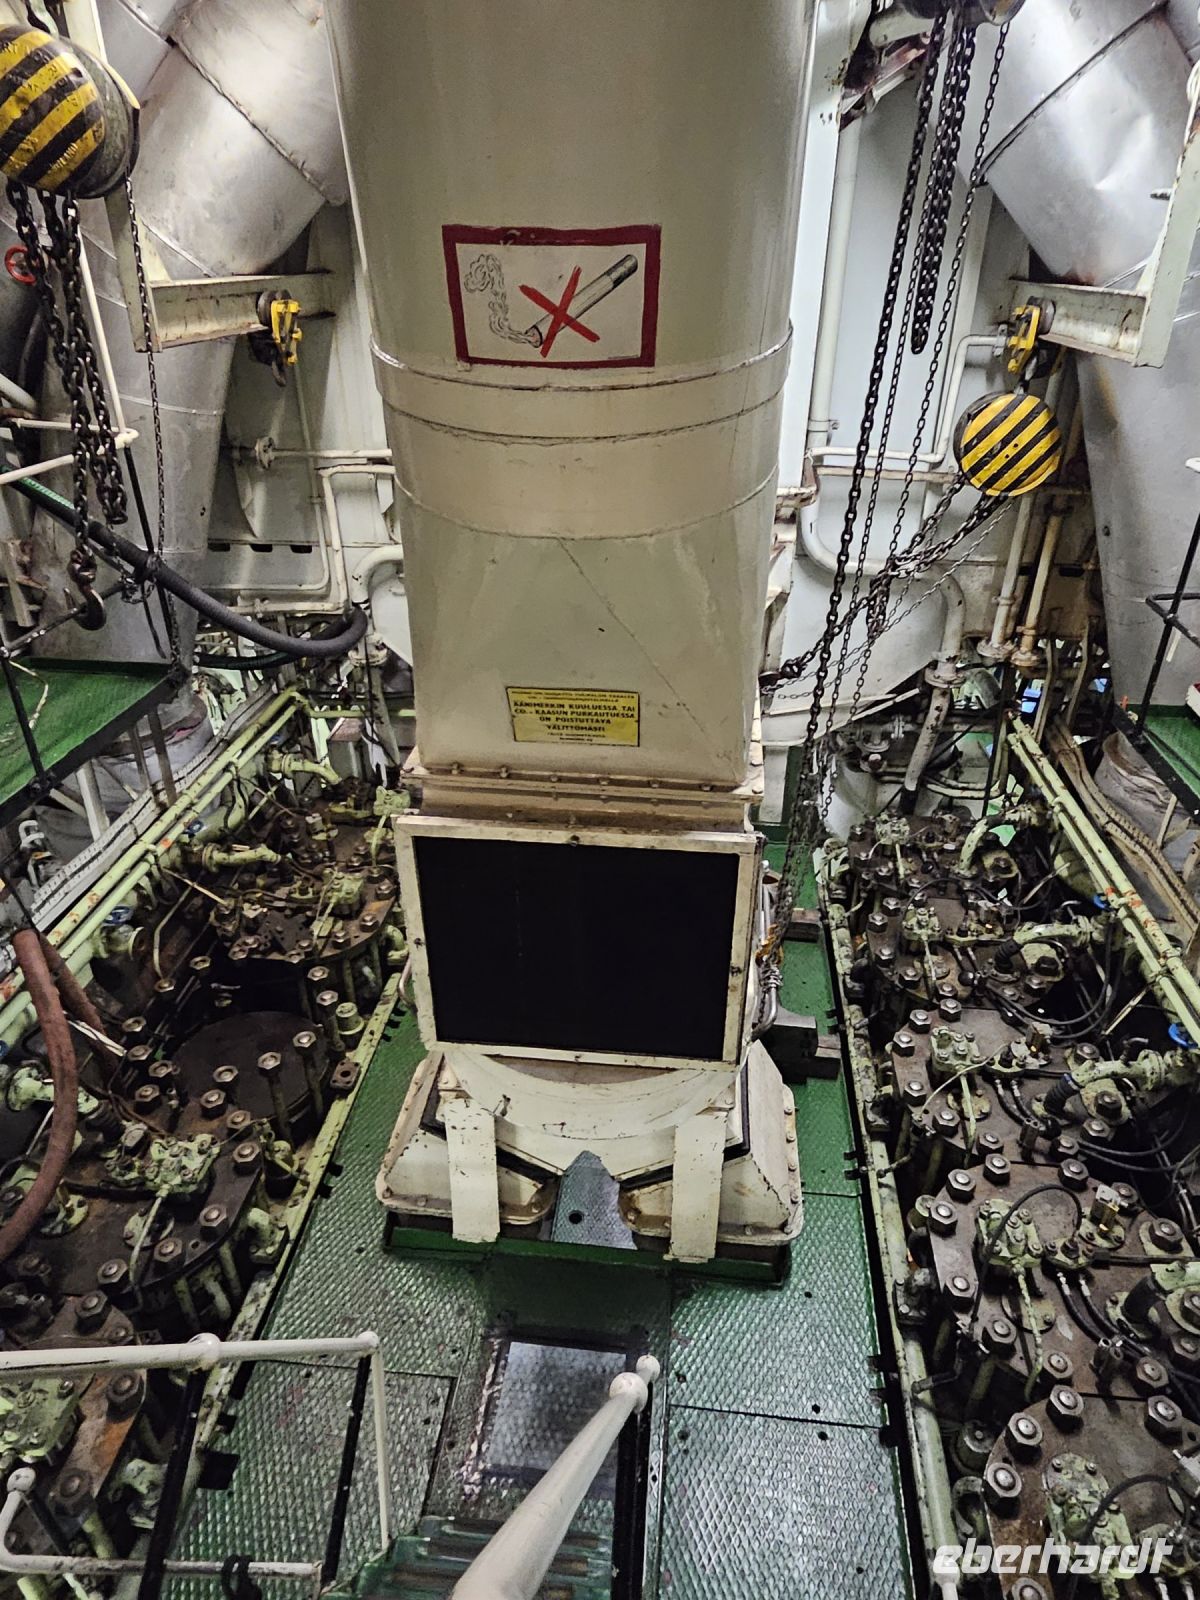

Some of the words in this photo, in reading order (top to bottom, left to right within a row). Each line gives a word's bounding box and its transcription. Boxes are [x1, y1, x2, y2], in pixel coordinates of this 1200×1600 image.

[569, 703, 617, 711] KUULUESSA
[570, 710, 635, 719] PURKAUTUESSA
[555, 716, 611, 725] POISTUTTAVA
